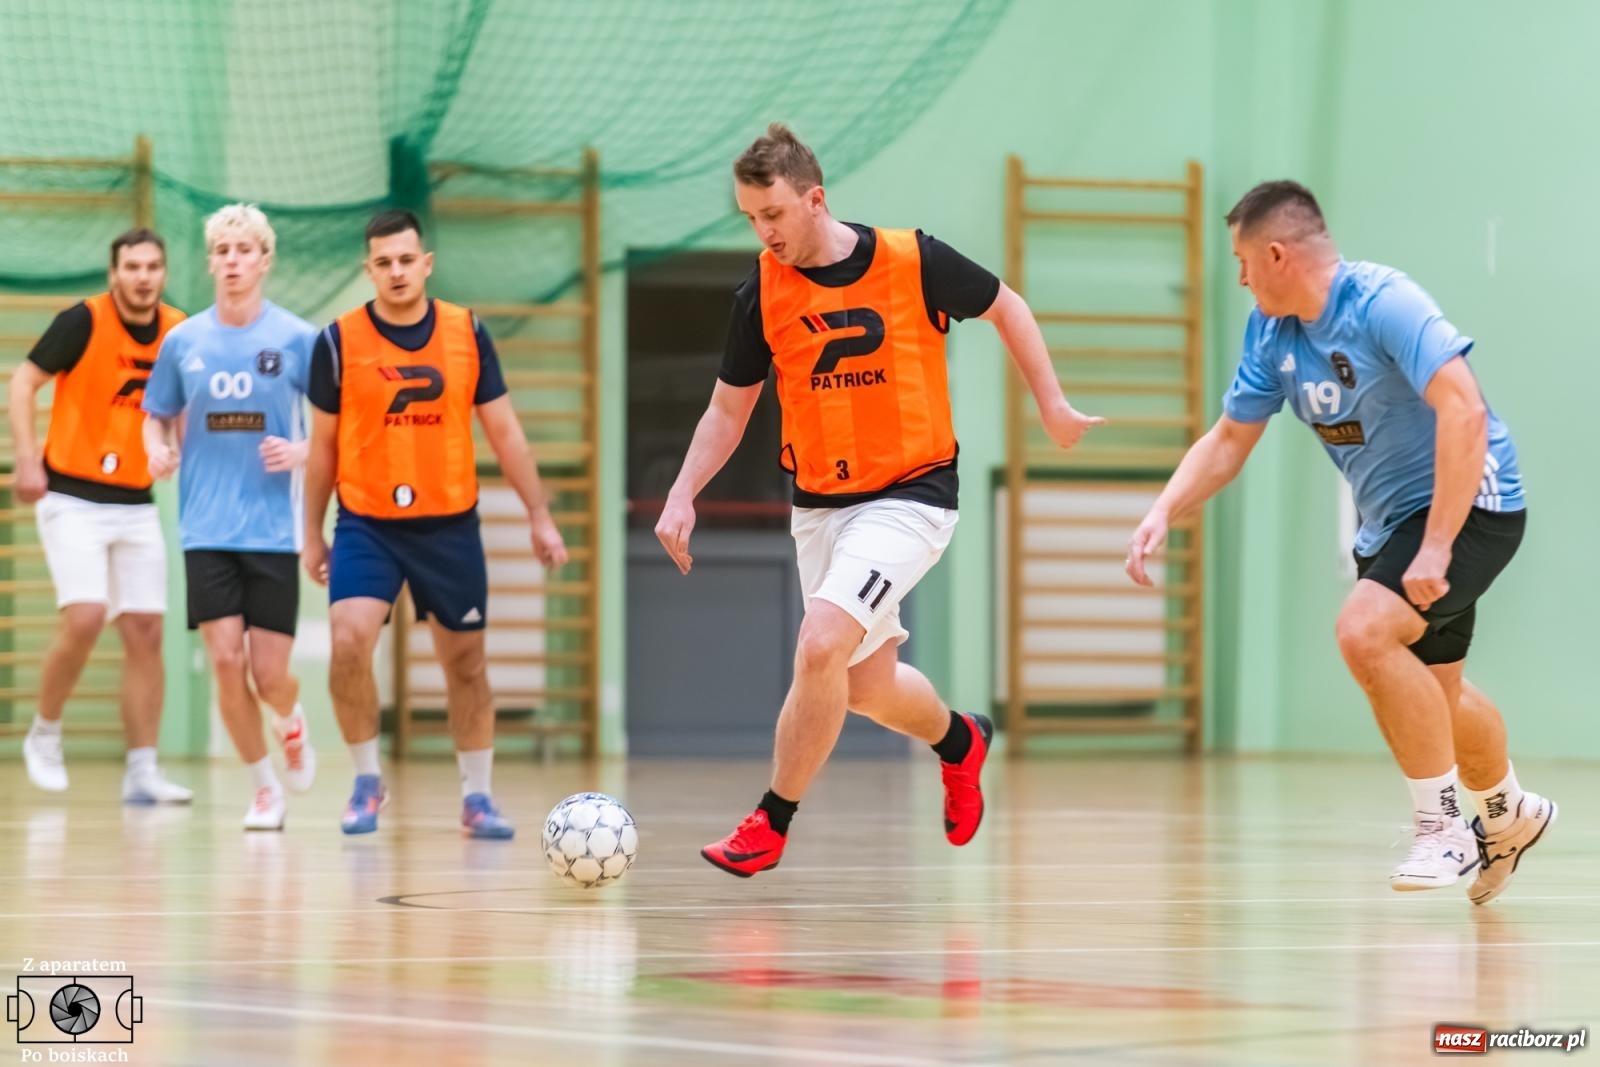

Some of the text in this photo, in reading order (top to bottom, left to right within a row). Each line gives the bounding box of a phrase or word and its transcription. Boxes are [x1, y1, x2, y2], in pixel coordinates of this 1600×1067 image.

[209, 371, 253, 400] 00
[811, 368, 886, 392] PATRICK
[1303, 380, 1341, 415] 19
[383, 413, 444, 427] PATRICK
[835, 459, 850, 481] 3
[857, 569, 893, 614] 11
